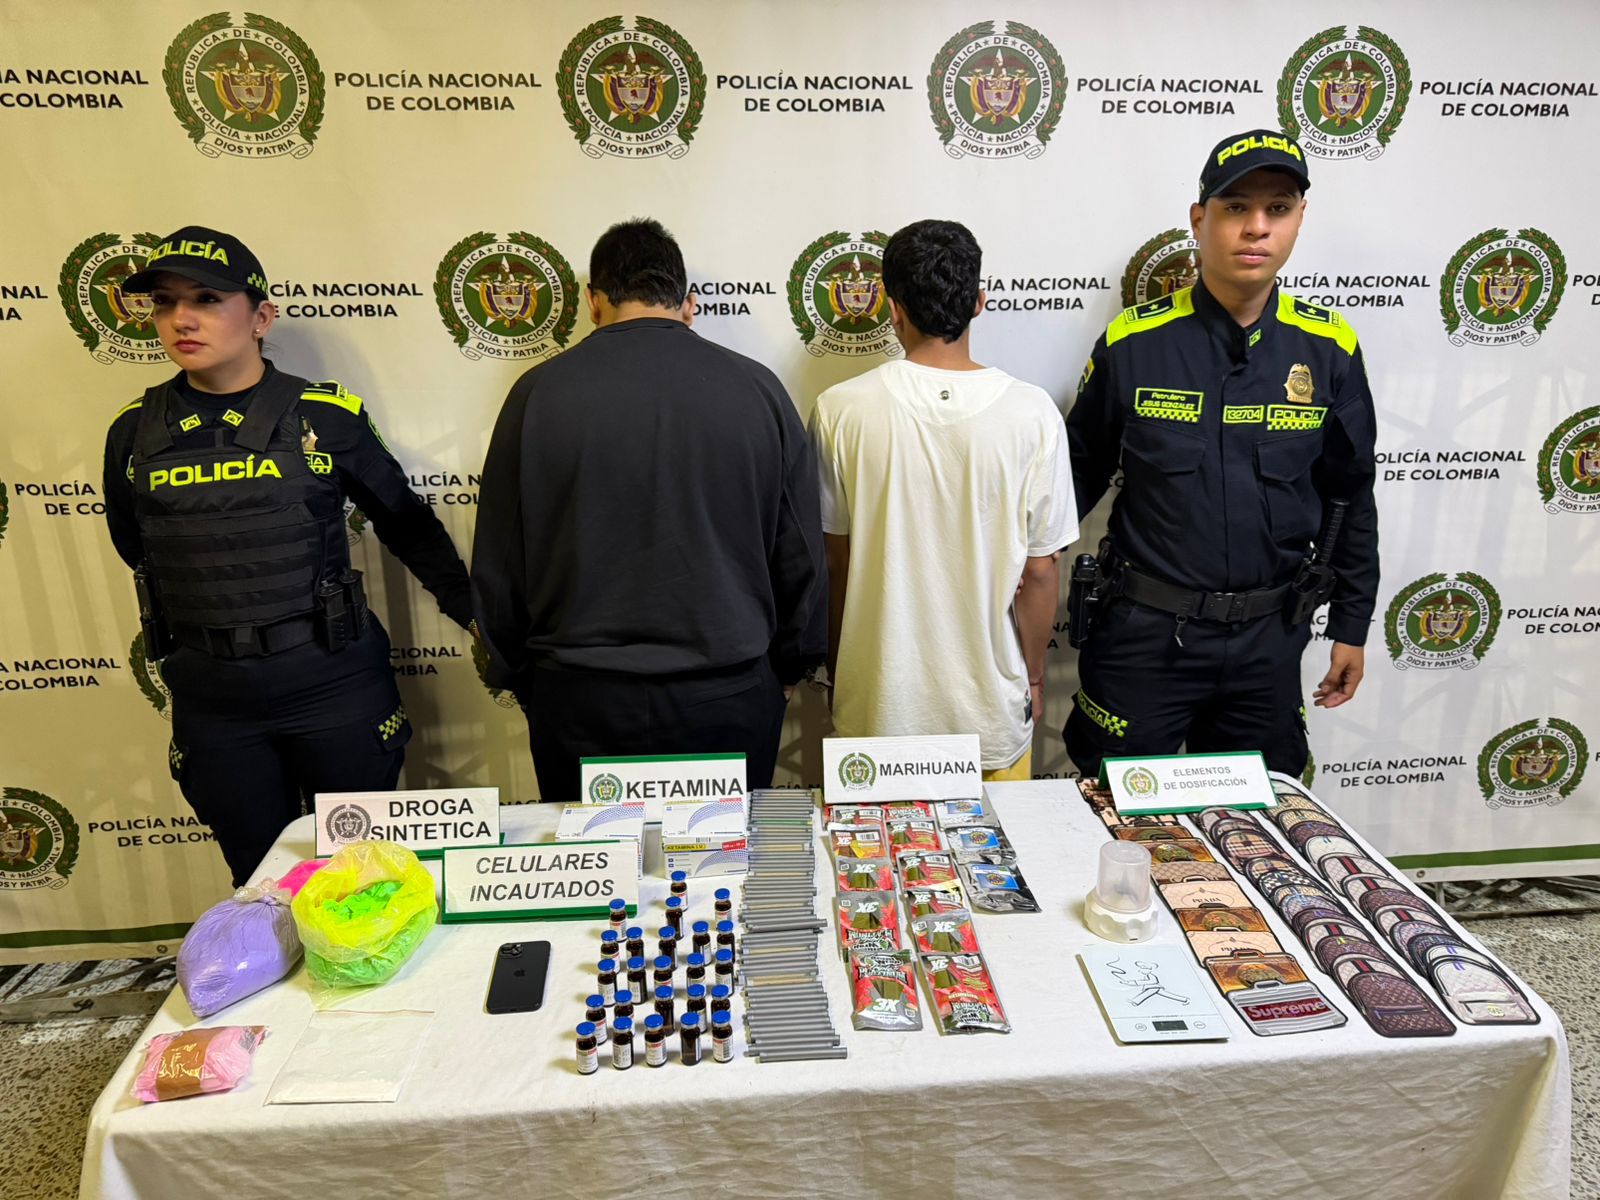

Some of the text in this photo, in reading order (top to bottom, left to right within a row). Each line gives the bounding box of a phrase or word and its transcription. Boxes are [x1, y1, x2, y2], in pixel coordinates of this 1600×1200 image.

[233, 29, 250, 38] DE
[265, 37, 307, 95] COLOMBIA
[624, 33, 640, 41] DE
[652, 40, 688, 97] COLOMBIA
[993, 37, 1009, 45] DE
[1020, 44, 1050, 98] COLOMBIA
[26, 70, 149, 84] NACIONAL
[1345, 41, 1359, 49] DE
[1369, 48, 1395, 101] COLOMBIA
[334, 70, 541, 88] POLICÍA NACIONAL
[717, 72, 913, 89] POLICÍA NACIONAL
[1077, 75, 1263, 93] POLICÍA NACIONAL
[1420, 79, 1598, 96] POLICÍA NACIONAL
[0, 93, 123, 108] COLOMBIA
[367, 97, 515, 110] DE COLOMBIA
[745, 98, 885, 112] DE COLOMBIA
[1102, 100, 1235, 114] DE COLOMBIA
[1441, 104, 1569, 117] DE COLOMBIA
[255, 108, 306, 141] NACIONAL
[636, 110, 684, 142] NACIONAL
[996, 111, 1044, 142] NACIONAL
[1339, 113, 1386, 144] NACIONAL
[215, 138, 243, 153] DIOS
[257, 139, 295, 155] PATRIA
[598, 139, 624, 154] DIOS
[636, 140, 673, 155] PATRIA
[960, 140, 984, 154] DIOS
[995, 140, 1030, 155] PATRIA
[1304, 142, 1327, 155] DIOS
[1338, 143, 1370, 157] PATRIA
[122, 246, 138, 254] DE
[146, 240, 229, 267] POLICÍA
[497, 244, 512, 252] DE
[524, 250, 562, 303] COLOMBIA
[1528, 246, 1551, 293] COLOMBIA
[1012, 278, 1110, 290] NACIONAL
[1276, 273, 1431, 288] OLICÍA NACIONAL
[313, 284, 423, 296] NACIONAL
[689, 282, 776, 295] ACIONAL
[287, 305, 398, 317] COLOMBIA
[693, 303, 751, 315] OMBIA
[985, 298, 1084, 311] COLOMBIA
[1496, 304, 1542, 332] NACIONAL
[512, 314, 559, 345] NACIONAL
[856, 319, 892, 342] NACION
[1464, 330, 1485, 342] DIOS
[1494, 330, 1527, 343] PATRIA
[108, 346, 136, 360] DIOS
[476, 342, 502, 356] DIOS
[513, 343, 549, 357] PATRIA
[821, 339, 845, 352] DIOS
[856, 339, 890, 353] PATRIA
[1228, 409, 1260, 420] 132704
[1376, 450, 1525, 464] OLICÍA NACIONAL
[150, 454, 282, 491] POLICÍA
[411, 471, 462, 486] LICÍA
[1385, 469, 1500, 480] DE COLOMBIA
[15, 480, 96, 496] POLICÍA
[45, 503, 70, 515] DE
[1466, 586, 1488, 625] COLOMBIA
[1507, 605, 1569, 619] POLICÍA
[1525, 624, 1545, 634] DE
[390, 647, 462, 659] CIONAL
[14, 658, 121, 672] NACIONAL
[1435, 657, 1467, 667] PATRIA
[880, 761, 977, 776] MARIHUANA
[1173, 766, 1230, 777] ELEMENTOS
[1323, 756, 1466, 773] POLICÍA NACIONAL
[1164, 776, 1247, 790] DE DOSIFICACIÓN
[1341, 772, 1444, 787] DE COLOMBIA
[626, 778, 744, 799] KETAMINA
[389, 798, 473, 818] DROGA
[22, 803, 62, 842] COLOMBIA
[88, 816, 165, 833] POLICÍA
[370, 821, 491, 841] SINTETICA
[118, 832, 216, 847] DE COLOM
[476, 852, 609, 874] CELULARES
[20, 876, 52, 887] PATRIA
[470, 879, 615, 902] INCAUTADOS
[1248, 1000, 1326, 1018] Supreme
